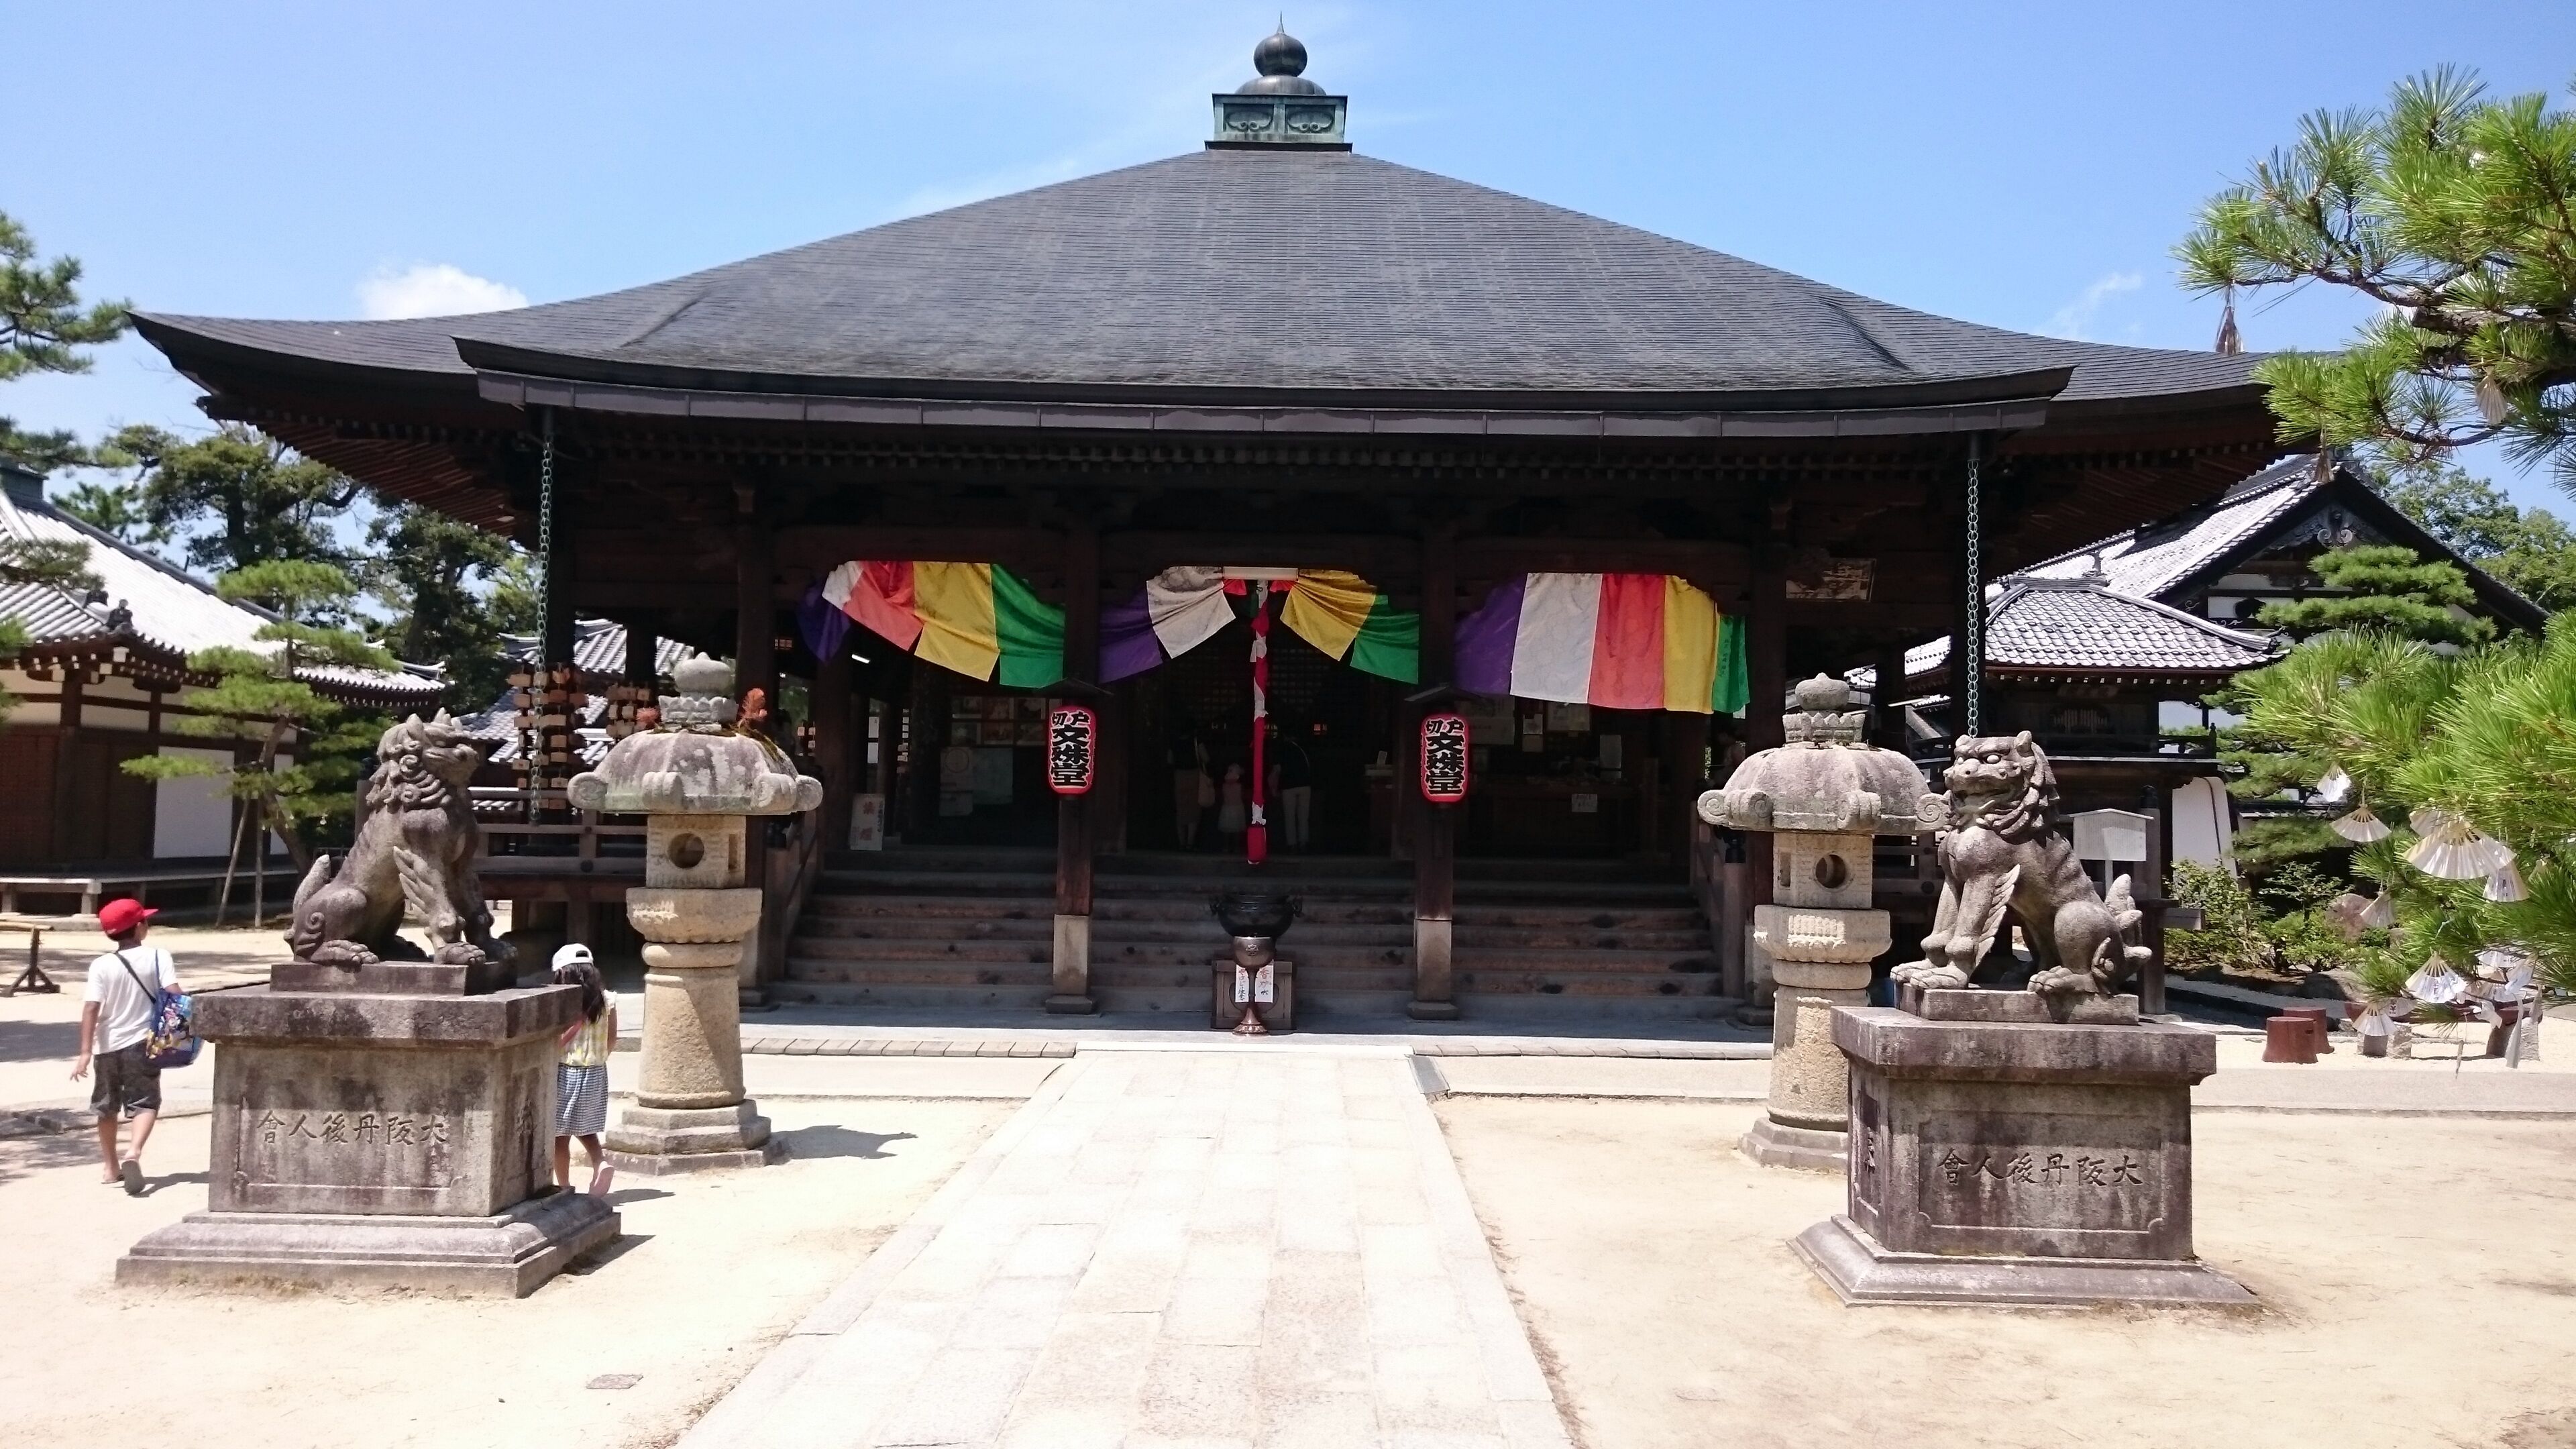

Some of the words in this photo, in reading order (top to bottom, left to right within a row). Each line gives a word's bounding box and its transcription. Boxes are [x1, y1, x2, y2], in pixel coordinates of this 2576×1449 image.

[1051, 724, 1091, 787] 文殊堂
[1425, 732, 1465, 795] 文殊堂
